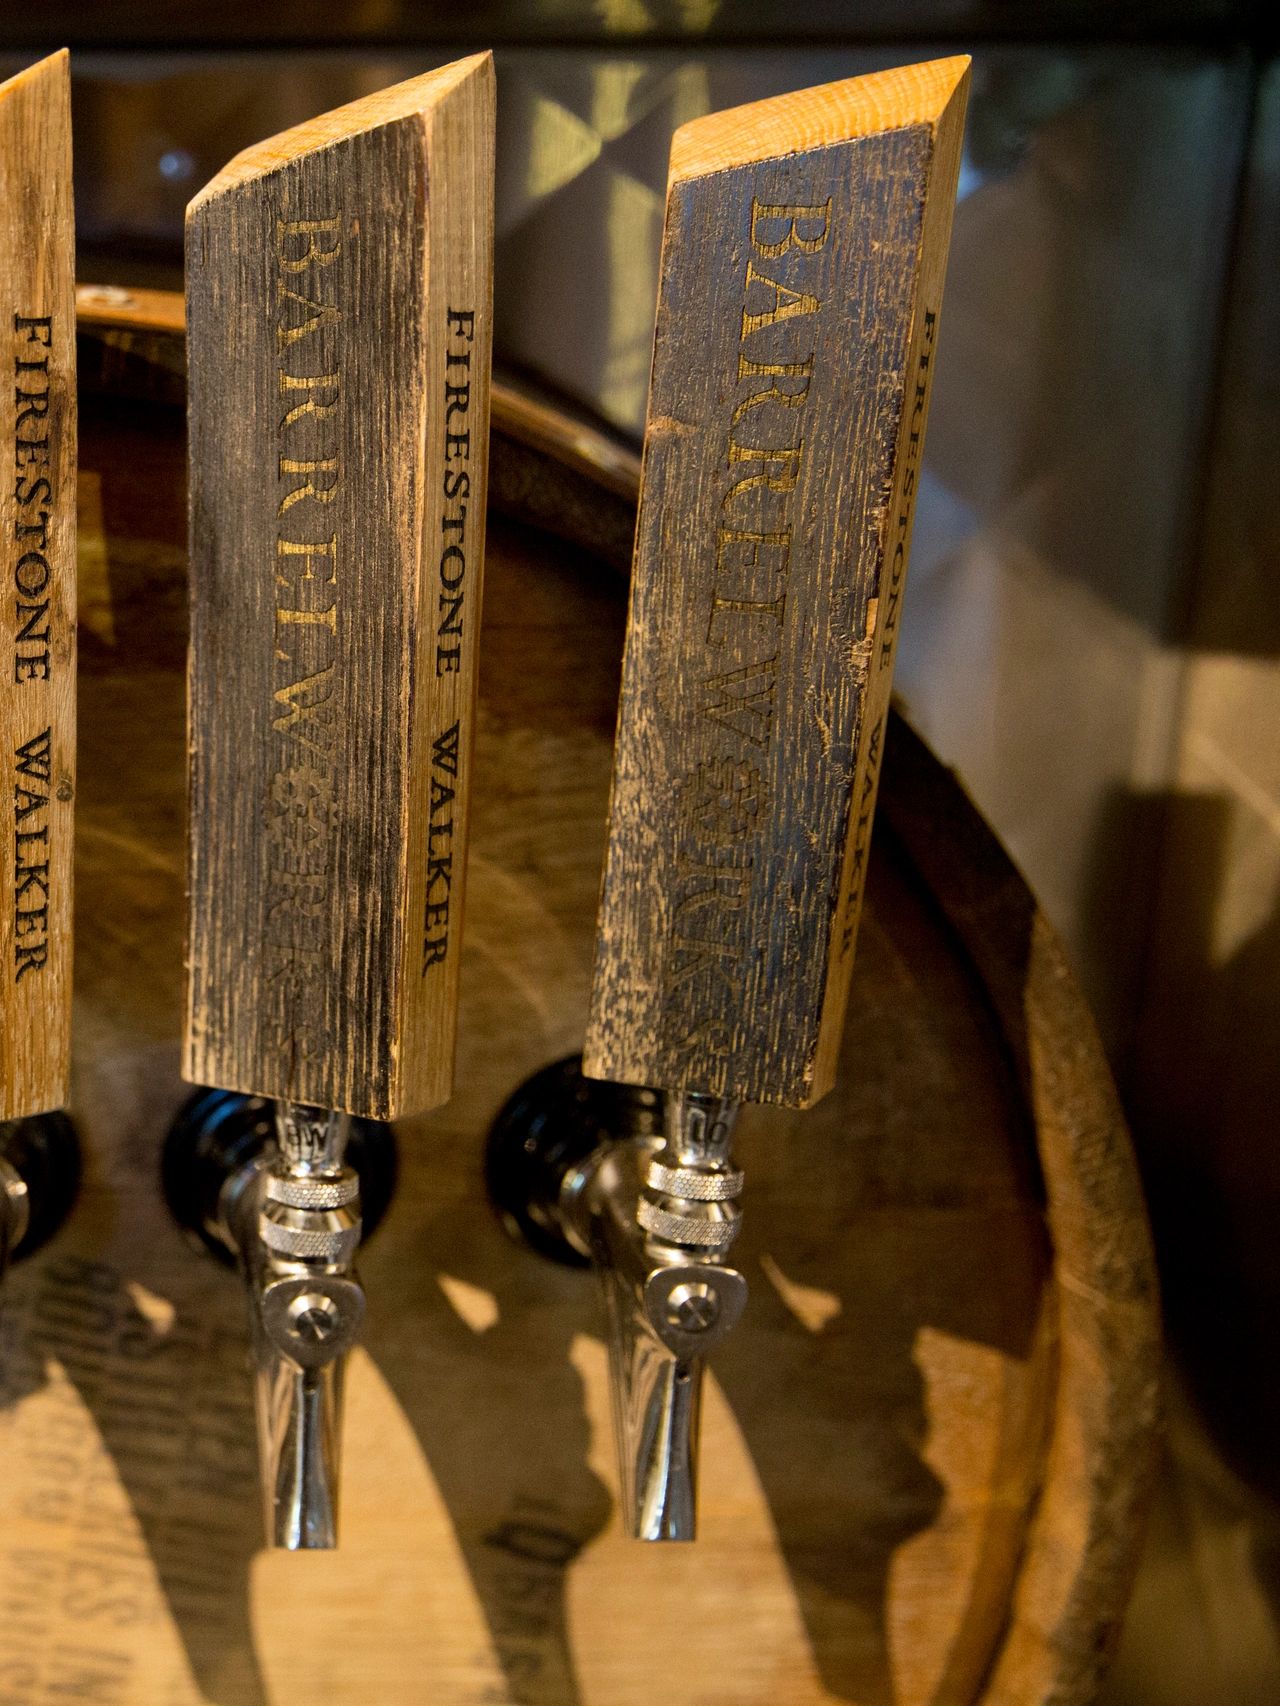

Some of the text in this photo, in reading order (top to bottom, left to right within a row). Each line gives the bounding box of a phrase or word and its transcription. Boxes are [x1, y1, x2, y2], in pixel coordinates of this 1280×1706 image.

[14, 313, 53, 984] FIRESTONE WALKER
[421, 306, 476, 979] FIRESTONE WALKER
